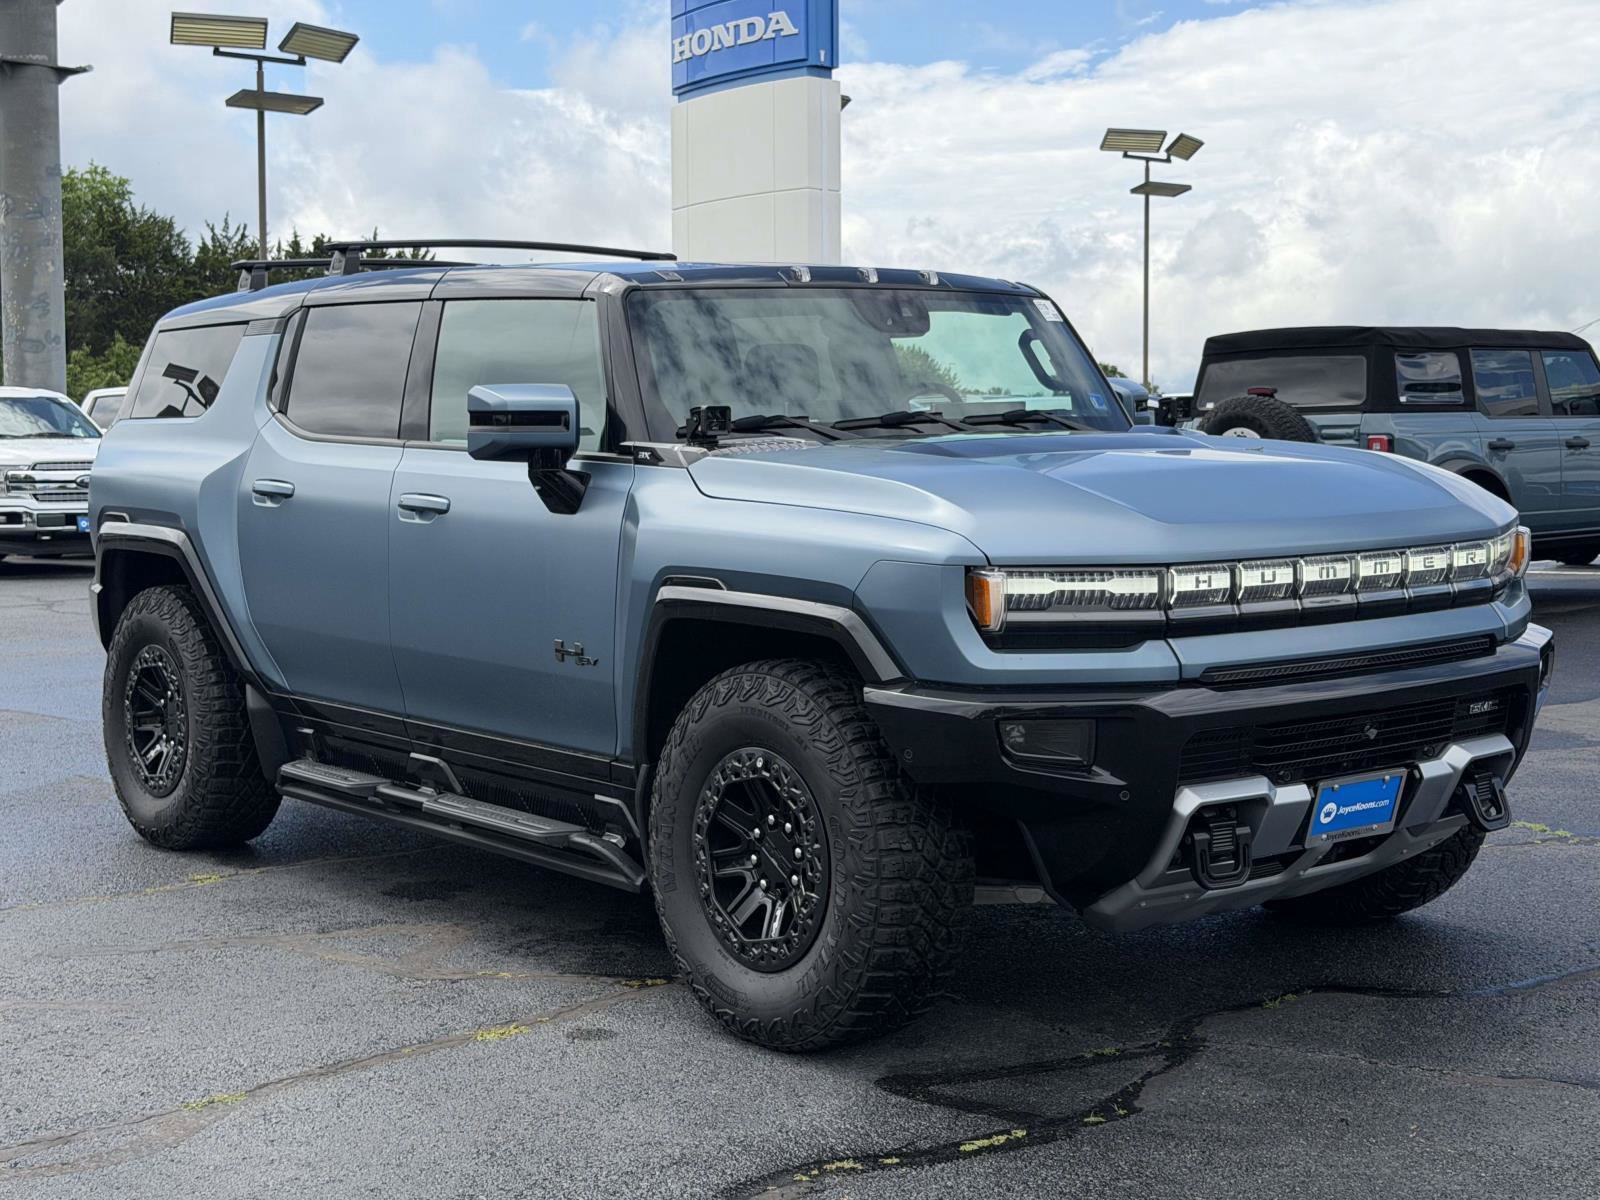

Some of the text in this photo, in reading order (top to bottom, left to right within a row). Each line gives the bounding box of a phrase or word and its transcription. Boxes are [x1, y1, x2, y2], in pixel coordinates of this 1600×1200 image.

[672, 11, 799, 64] HONDA
[1194, 550, 1478, 589] HUMMER
[1337, 799, 1390, 816] JoyceKoons.com
